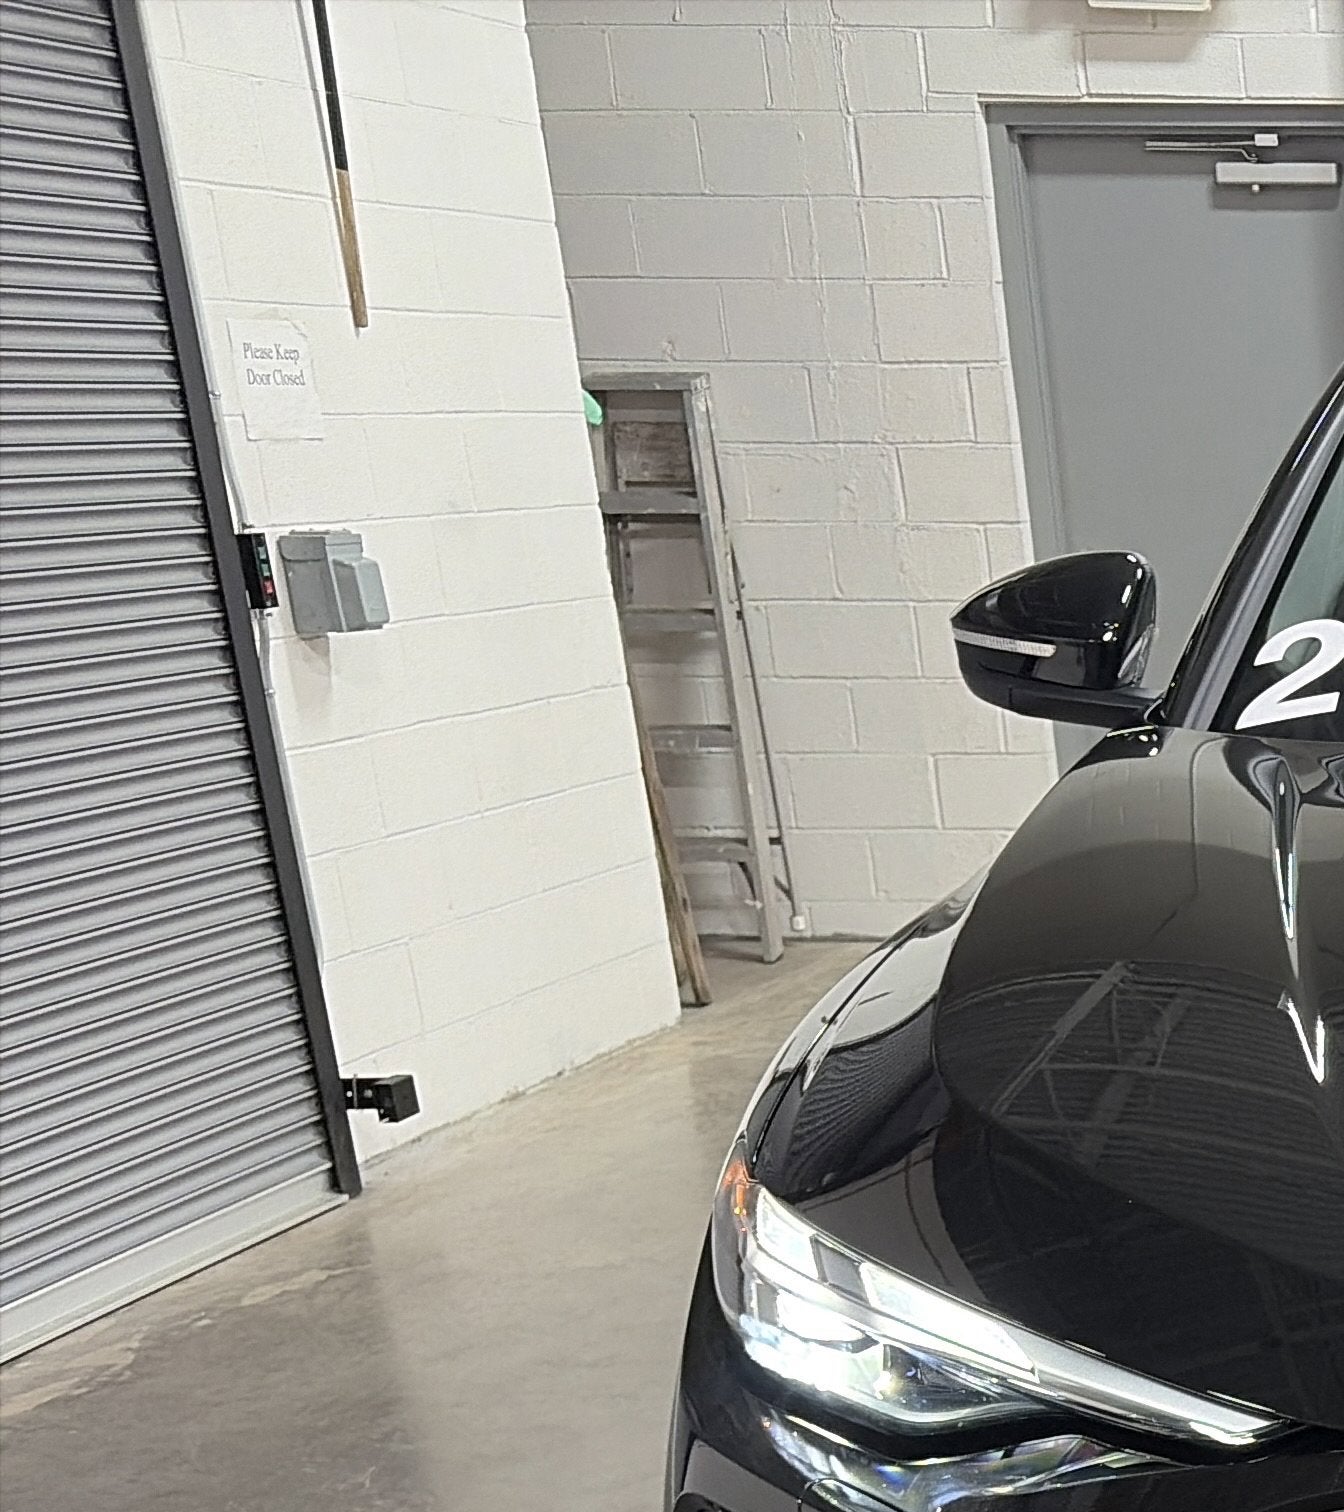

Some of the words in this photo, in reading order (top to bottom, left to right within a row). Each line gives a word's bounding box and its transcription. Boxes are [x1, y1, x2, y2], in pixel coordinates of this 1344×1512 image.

[243, 342, 273, 359] Please
[274, 343, 300, 365] Keep
[246, 368, 271, 385] Door
[273, 369, 305, 386] Closed
